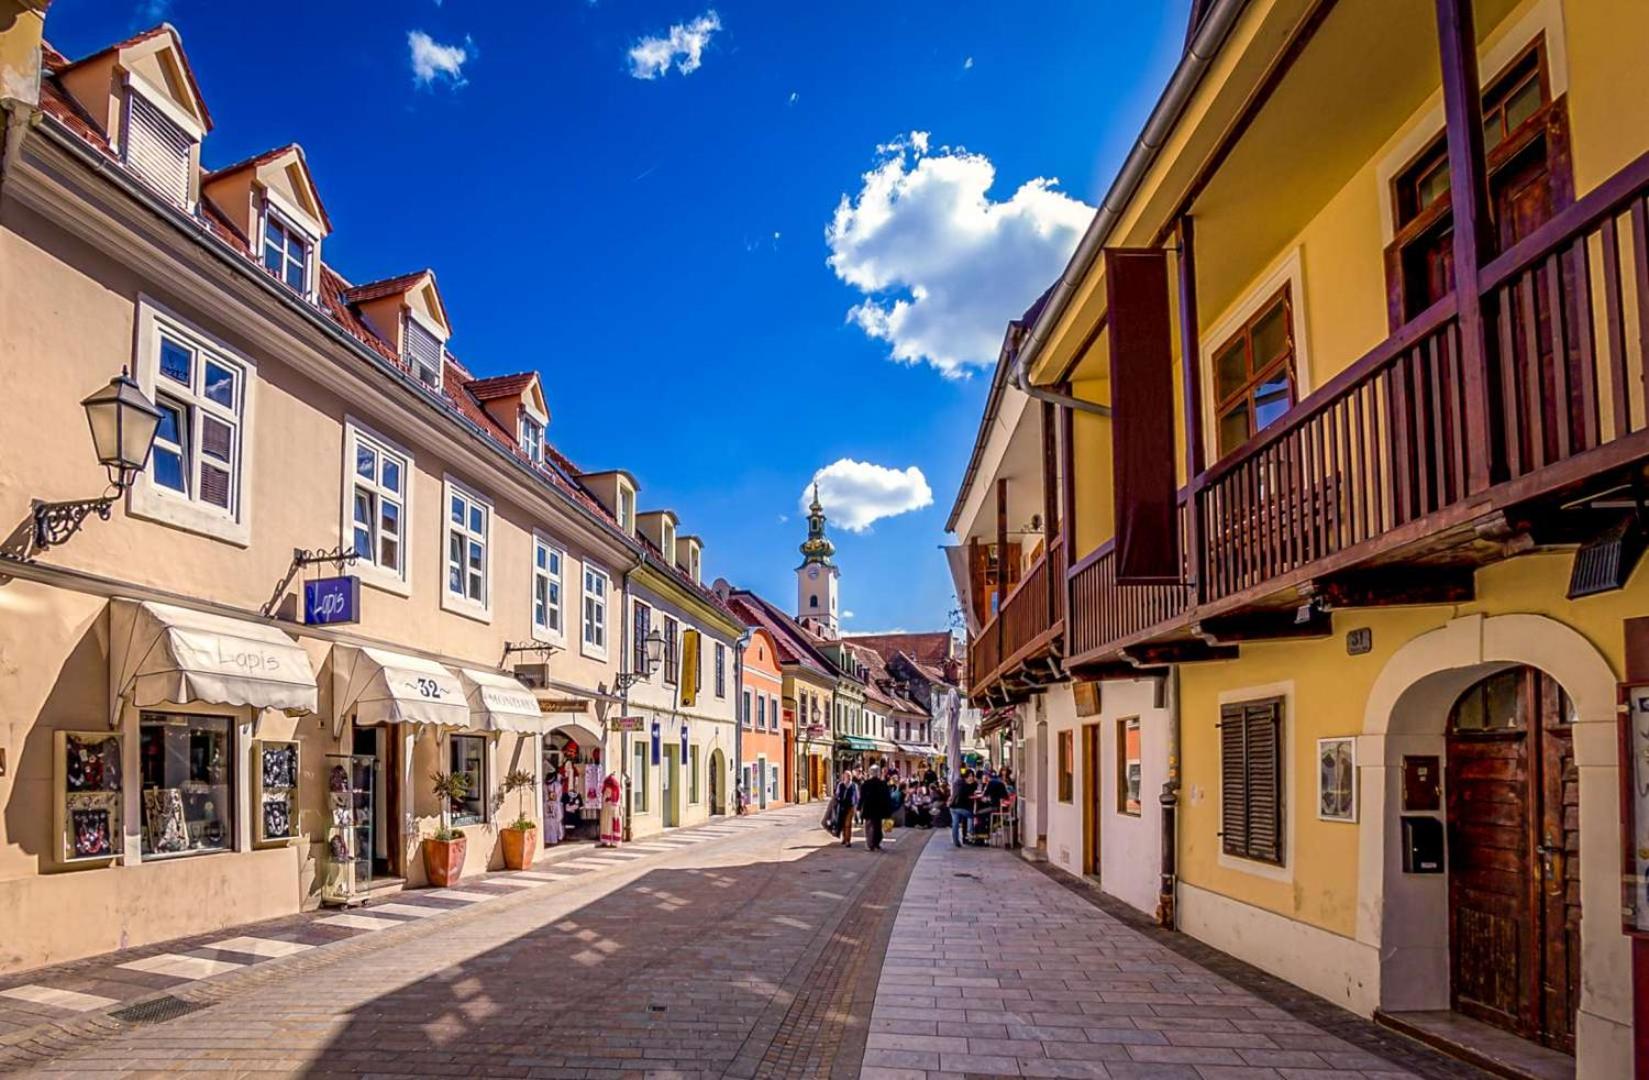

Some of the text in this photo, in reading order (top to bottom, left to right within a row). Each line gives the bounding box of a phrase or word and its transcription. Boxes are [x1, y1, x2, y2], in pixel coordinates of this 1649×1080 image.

[313, 582, 345, 622] Lapis
[217, 637, 280, 673] Lapis
[417, 678, 441, 699] 32
